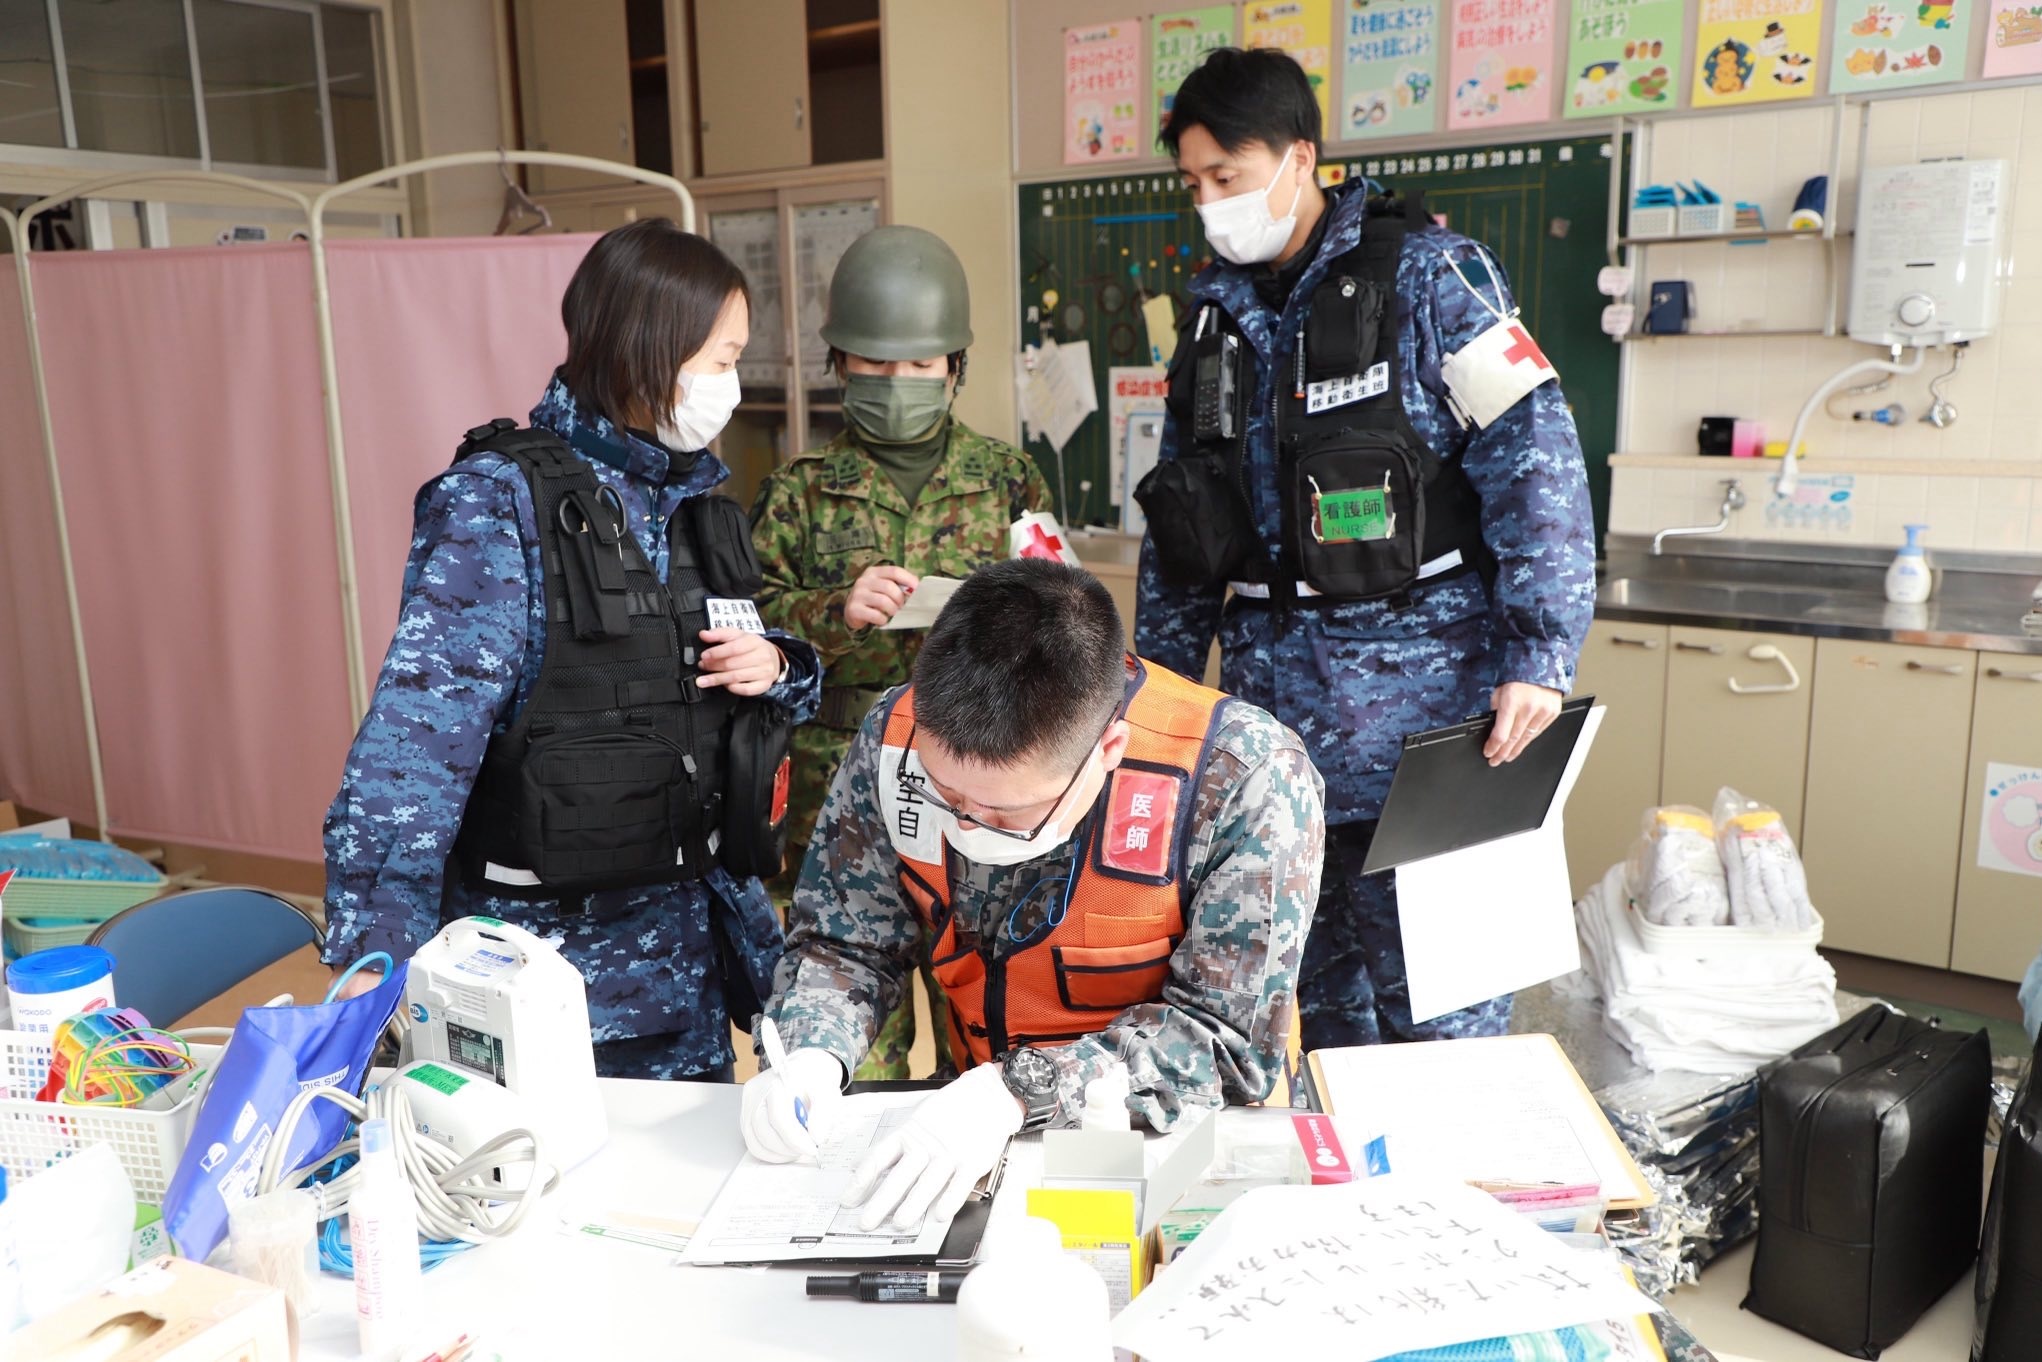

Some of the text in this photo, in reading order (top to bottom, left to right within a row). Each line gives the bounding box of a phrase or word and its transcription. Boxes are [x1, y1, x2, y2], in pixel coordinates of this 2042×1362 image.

[1070, 185, 1078, 199] 2
[1083, 184, 1091, 198] 3
[1096, 183, 1105, 196] 4
[1110, 181, 1118, 196] 5
[1138, 179, 1146, 193] 7
[1152, 178, 1160, 192] 8
[1166, 177, 1175, 192] 9
[1350, 163, 1362, 177] 21
[1366, 162, 1380, 176] 22
[1383, 160, 1397, 174] 23
[1400, 159, 1415, 173] 24
[1418, 157, 1432, 172] 25
[1435, 156, 1449, 171] 26
[1453, 154, 1467, 169] 27
[1472, 153, 1486, 168] 28
[1490, 151, 1504, 166] 29
[1509, 150, 1523, 165] 30
[1527, 148, 1541, 163] 31
[1311, 380, 1384, 409] 移動衛生班
[1324, 498, 1381, 520] 看護師
[1331, 522, 1378, 535] NURSE
[1125, 793, 1154, 852] 医師
[302, 1071, 345, 1092] THIS SID
[367, 1219, 384, 1319] Dry Shampoo
